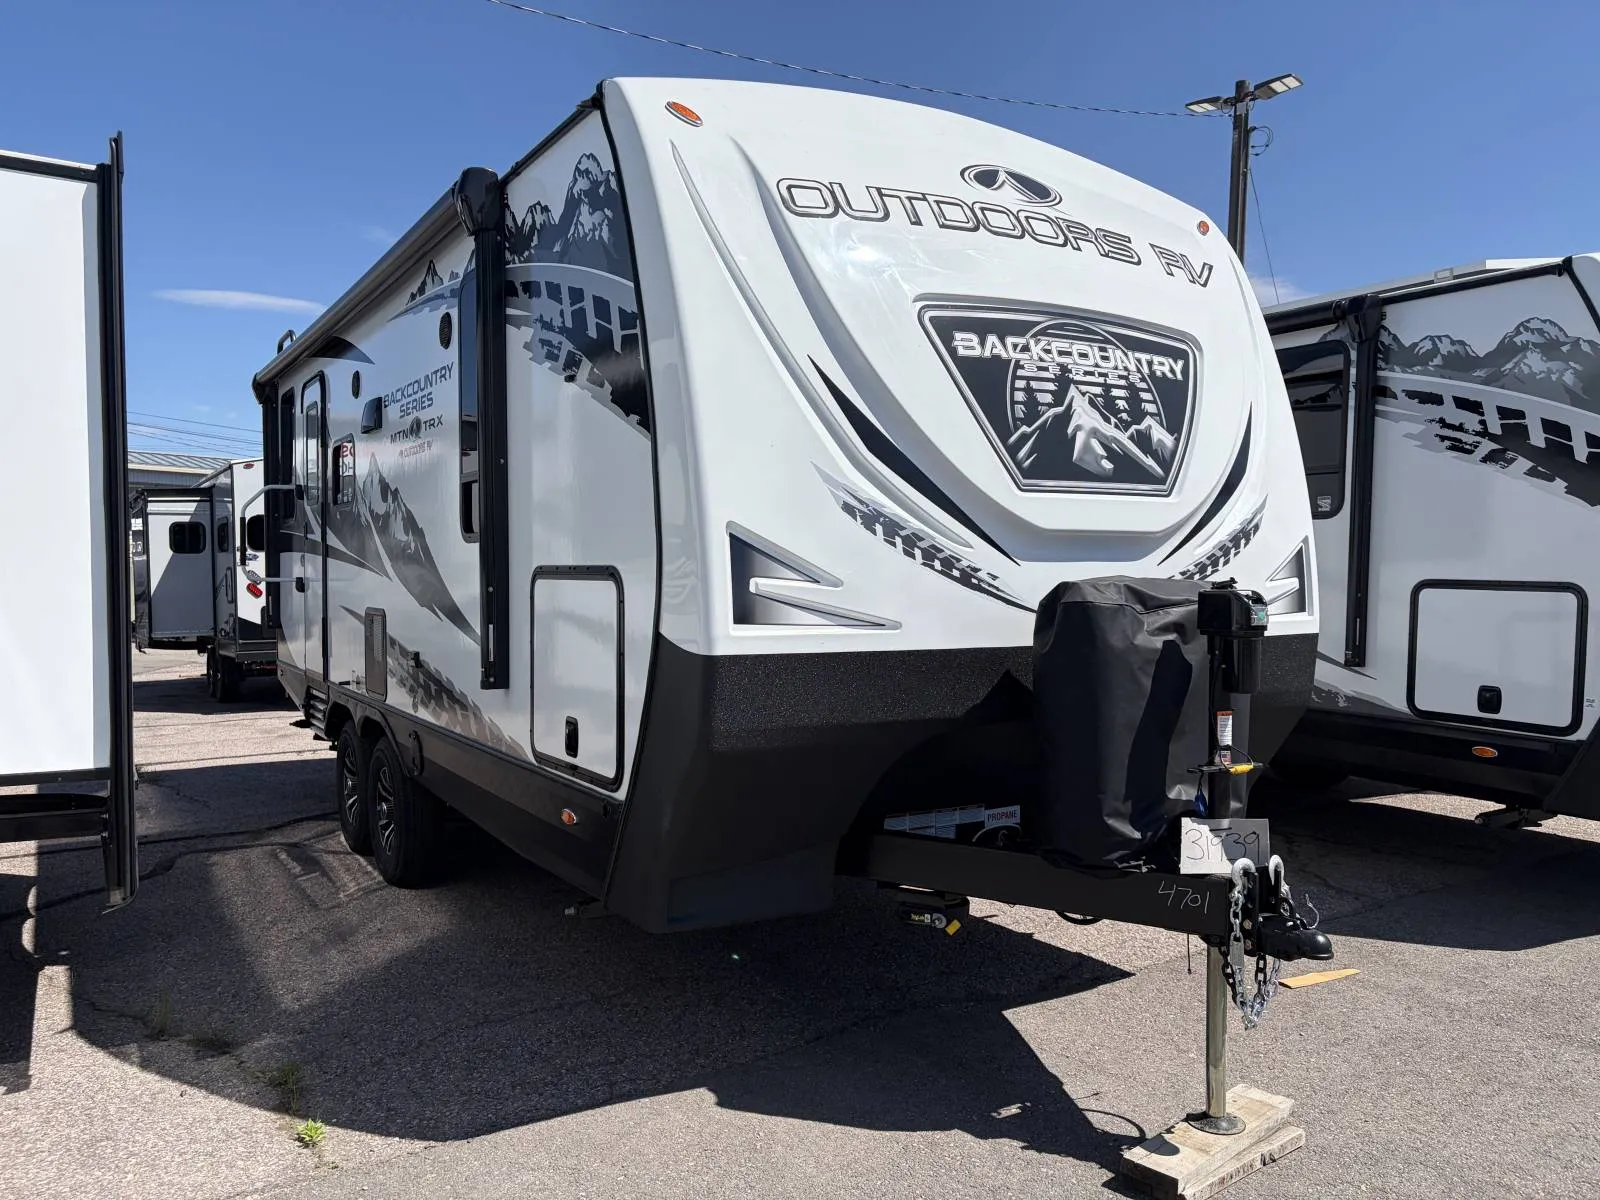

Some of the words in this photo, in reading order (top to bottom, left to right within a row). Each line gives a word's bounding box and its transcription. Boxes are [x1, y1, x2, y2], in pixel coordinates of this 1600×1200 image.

[777, 177, 1141, 266] OUTDOORS
[1149, 242, 1214, 288] RV
[952, 331, 1185, 381] BACKCOUNTRY
[1023, 363, 1142, 383] SERIES
[383, 361, 454, 409] BACKCOUNTRY
[399, 391, 434, 419] SERIES
[390, 429, 410, 445] MTN
[423, 414, 444, 432] TRX
[987, 809, 1018, 823] PROPANE
[1185, 828, 1260, 865] 31939
[1158, 880, 1210, 914] 4701
